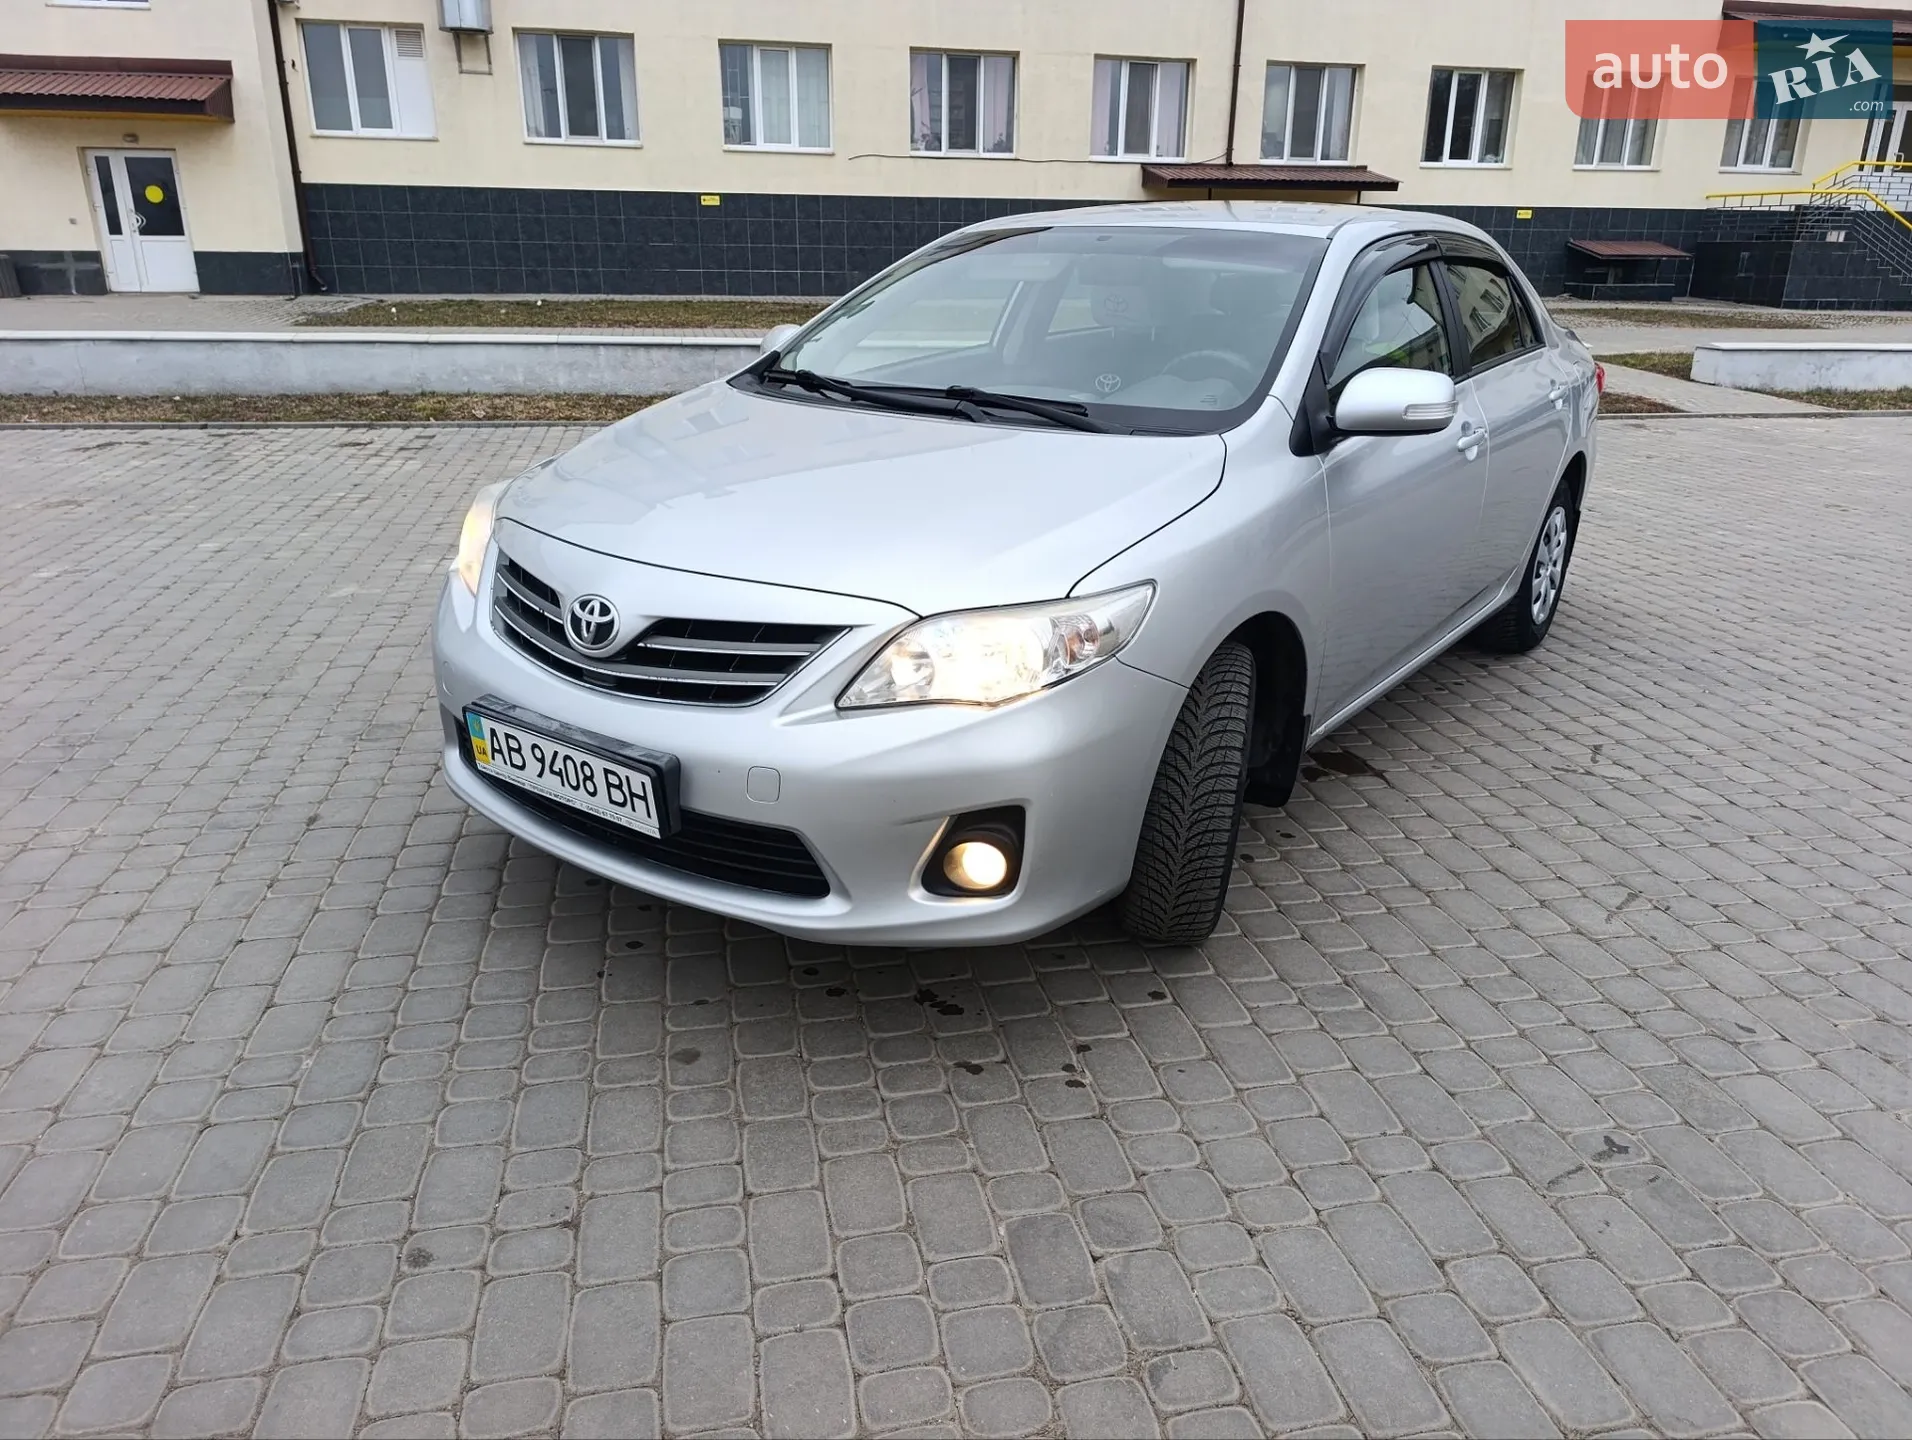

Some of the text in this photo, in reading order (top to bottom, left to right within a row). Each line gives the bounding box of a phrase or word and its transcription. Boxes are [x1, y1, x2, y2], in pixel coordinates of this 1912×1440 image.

[475, 744, 488, 757] UA
[490, 727, 527, 771] AB
[531, 743, 598, 798] 9408
[603, 767, 652, 819] BH
